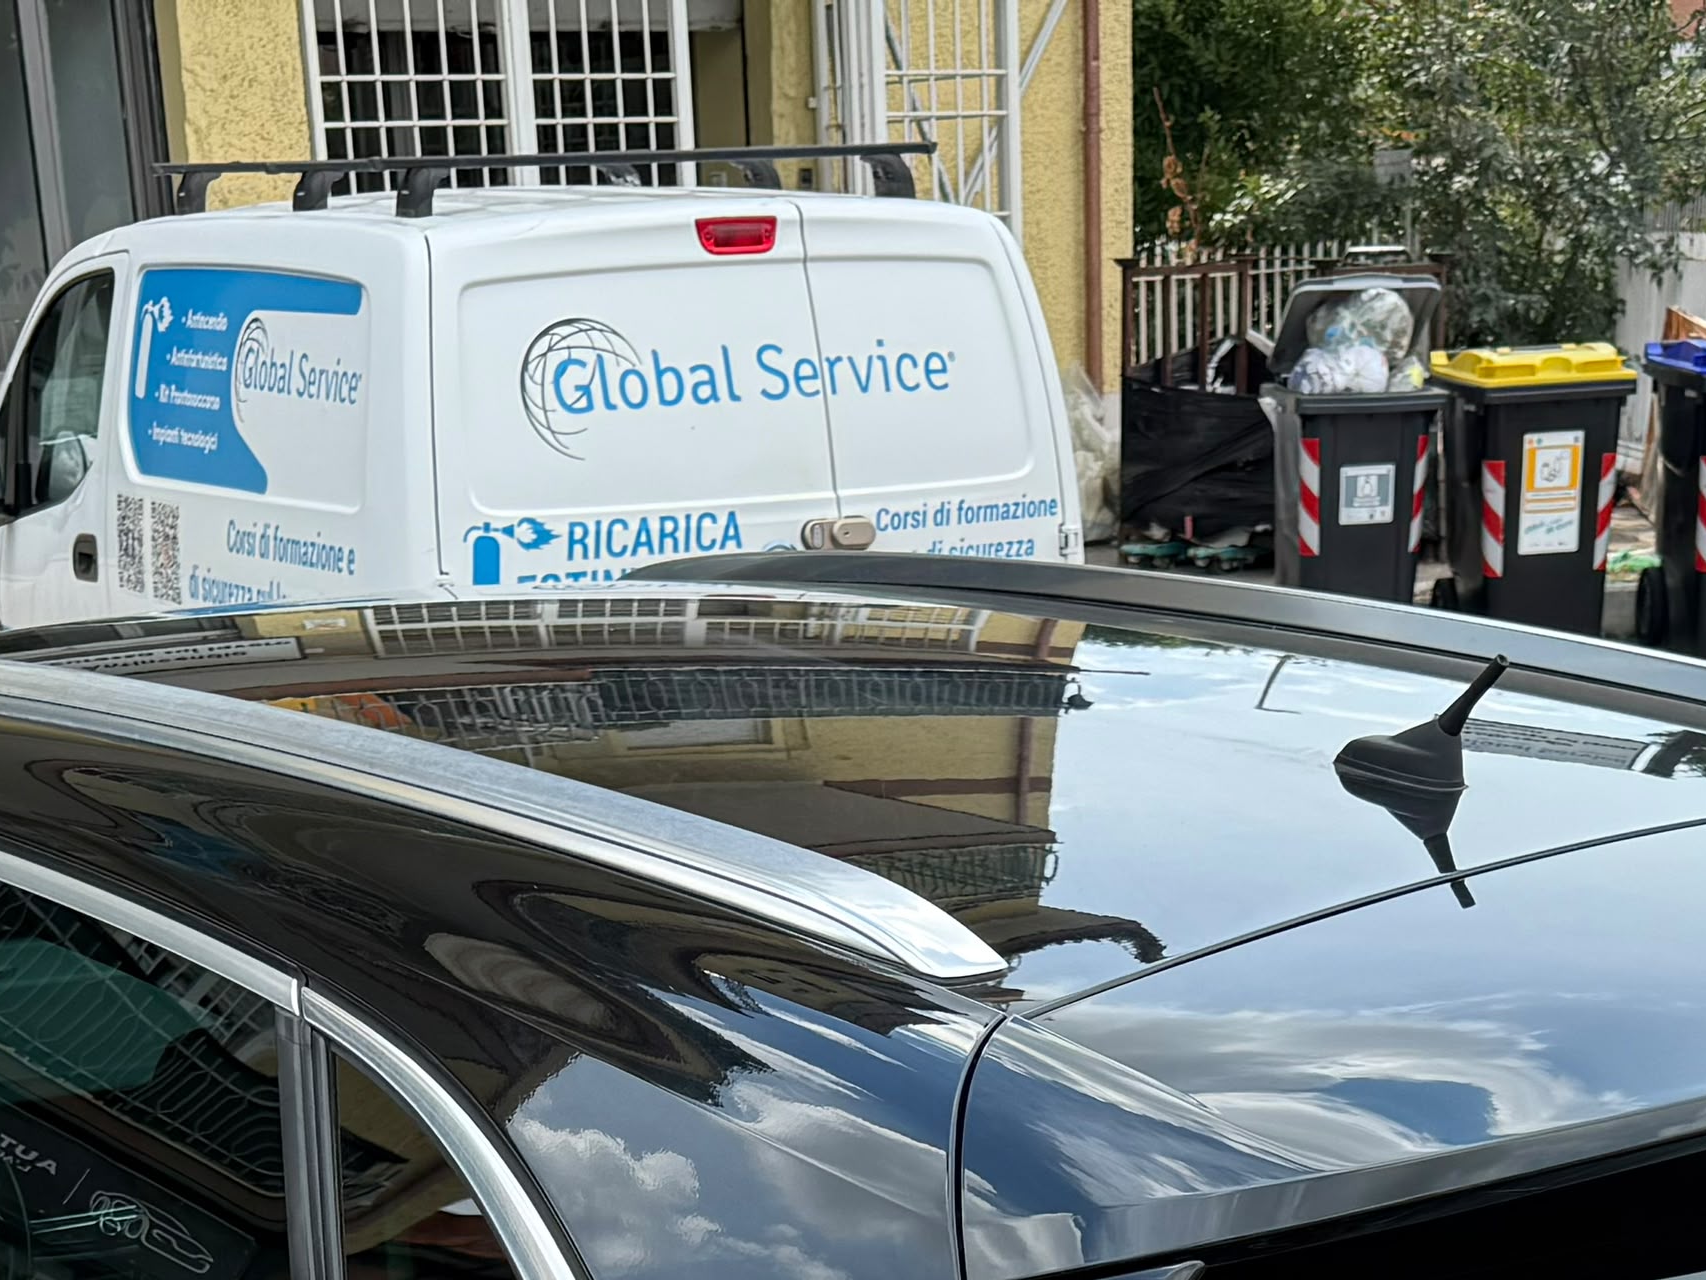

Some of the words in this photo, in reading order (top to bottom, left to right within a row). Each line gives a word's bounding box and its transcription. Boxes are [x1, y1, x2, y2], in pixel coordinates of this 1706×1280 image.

[244, 347, 292, 395] Global
[296, 353, 357, 404] Service
[553, 343, 741, 415] Global
[756, 338, 950, 401] Service
[566, 510, 743, 562] RICARICA
[876, 503, 927, 532] Corsi
[933, 501, 951, 527] di
[957, 494, 1059, 525] formazione
[227, 519, 258, 557] Corsi
[259, 523, 271, 560] di
[272, 525, 345, 573] formazione
[347, 547, 355, 576] e
[189, 564, 200, 599] di
